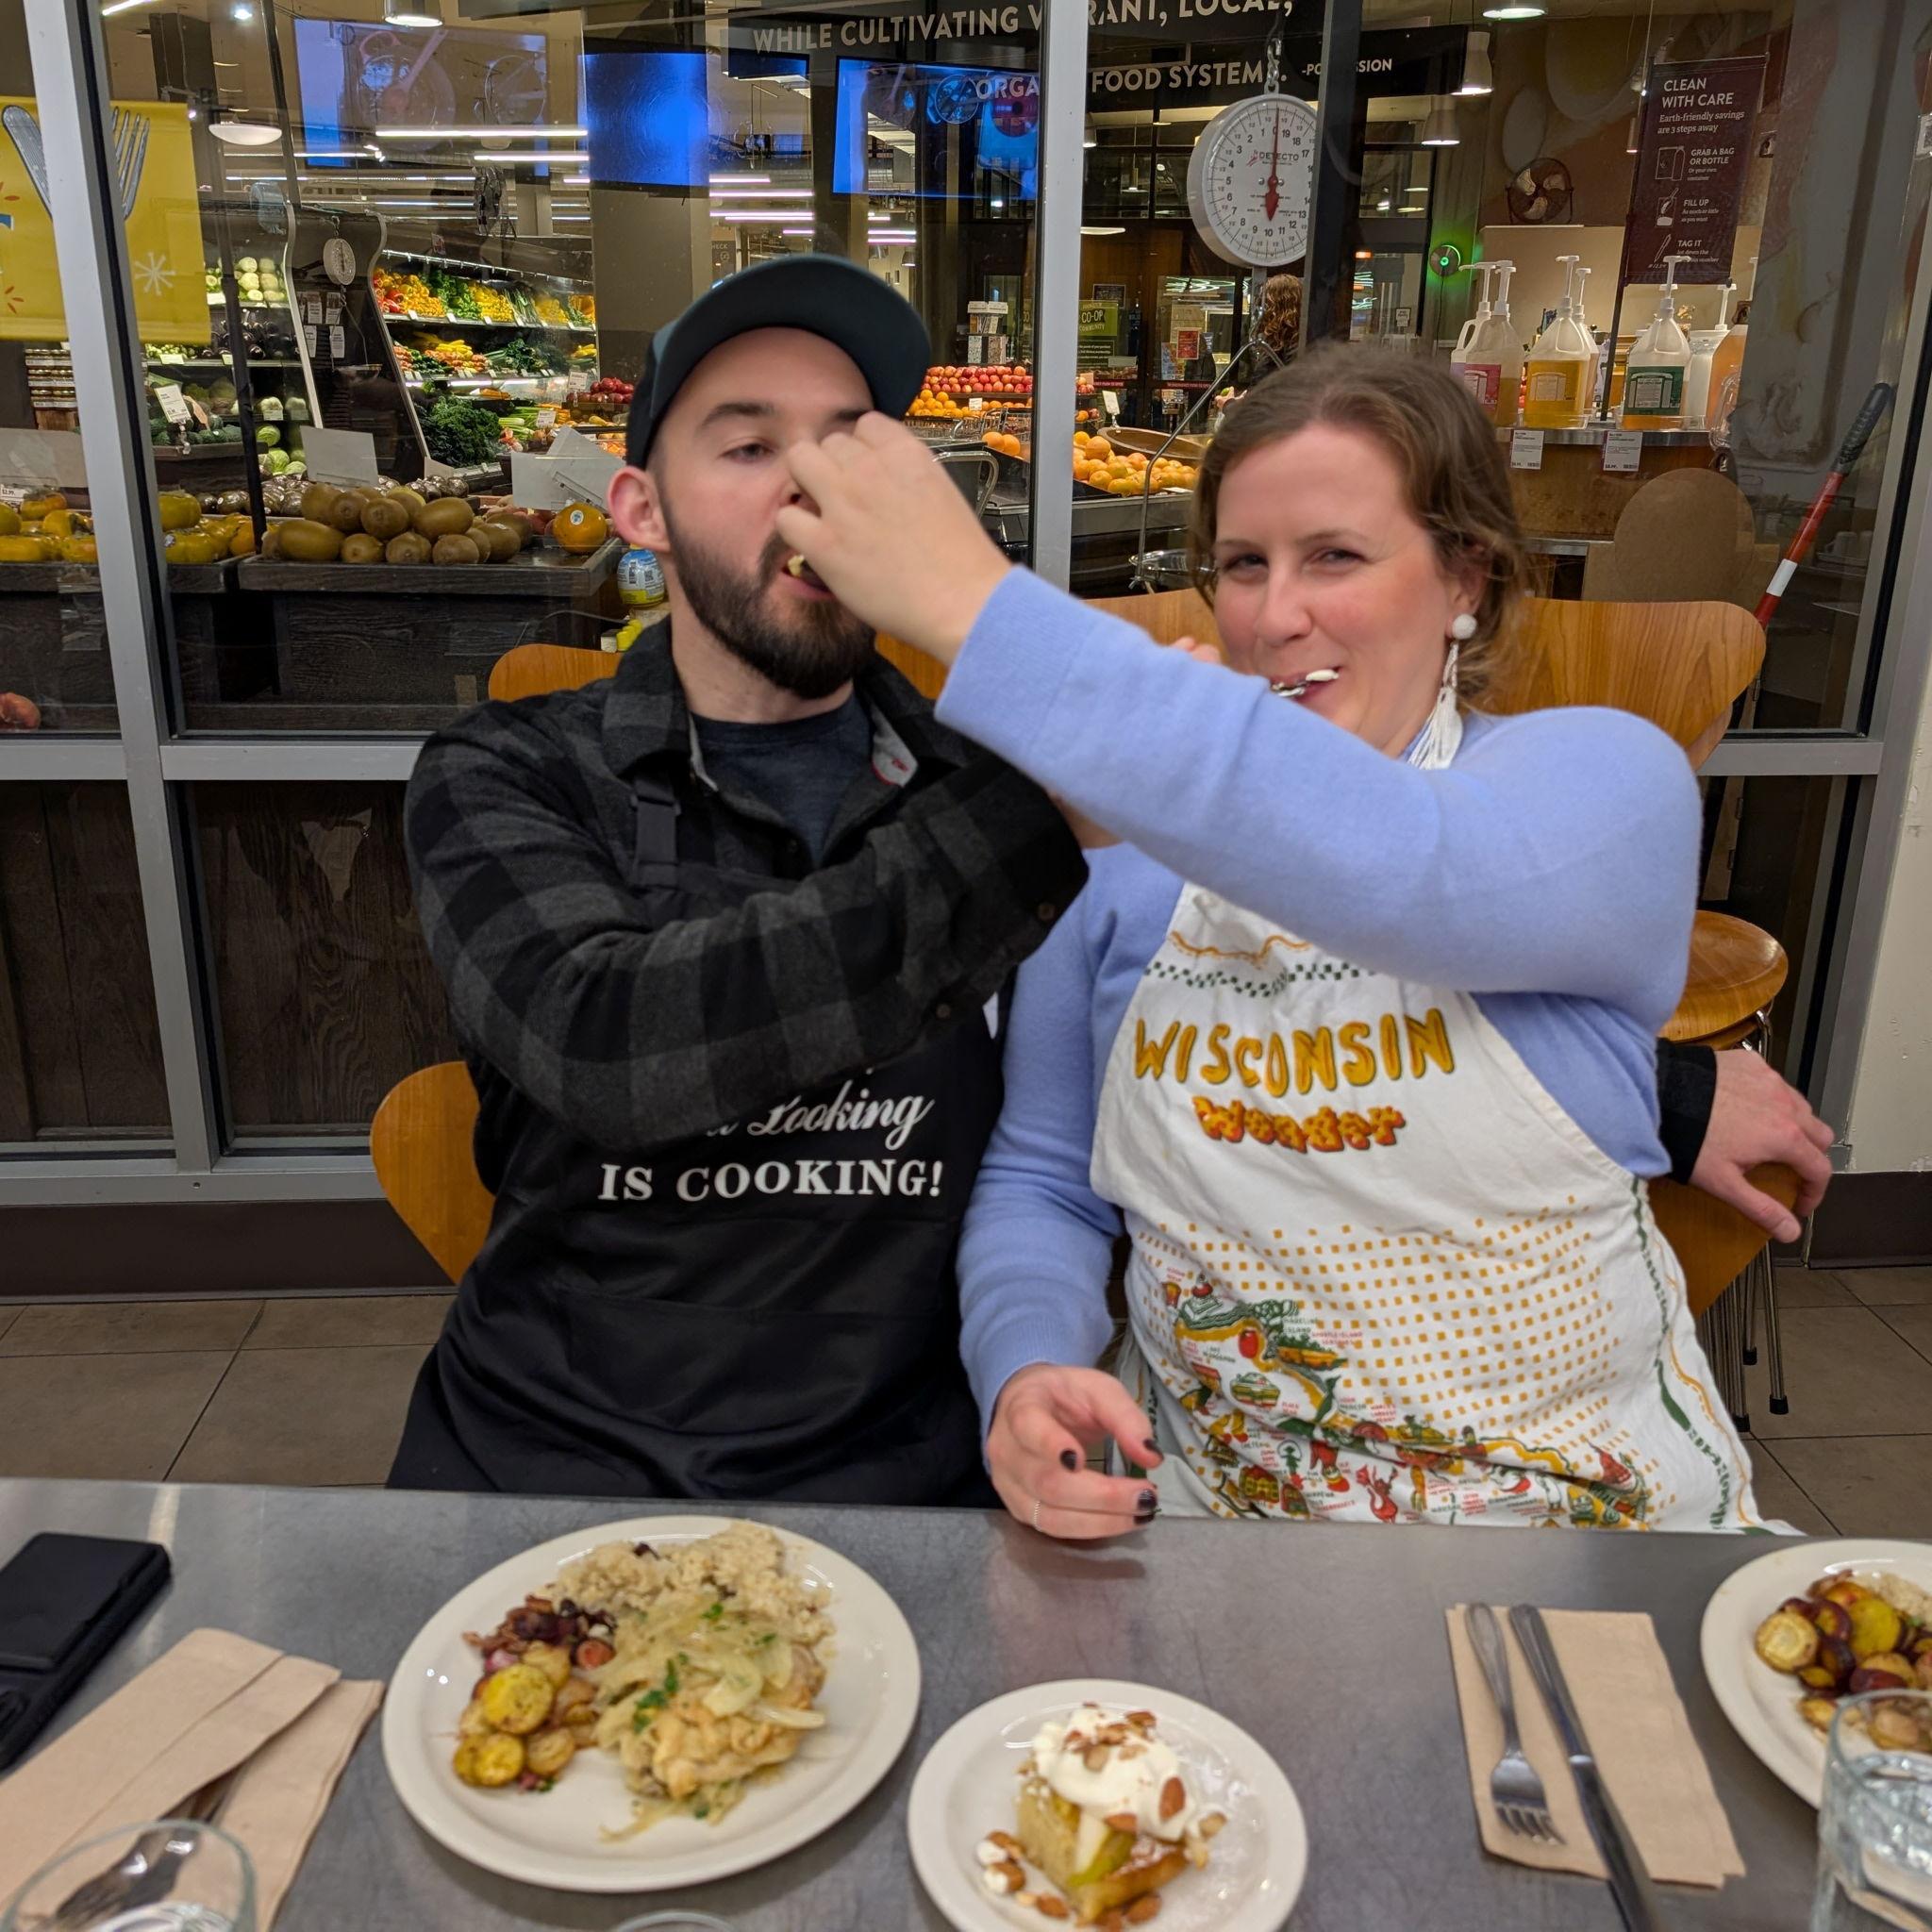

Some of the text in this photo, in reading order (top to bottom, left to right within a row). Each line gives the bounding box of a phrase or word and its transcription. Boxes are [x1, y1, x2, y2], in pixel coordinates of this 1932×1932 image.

[753, 24, 832, 54] WHILE
[841, 6, 1019, 46] CULTIVATING
[975, 76, 1041, 100] ORGA
[1091, 66, 1161, 92] FOOD
[1169, 60, 1288, 89] SYSTEM.
[1356, 58, 1392, 73] SION
[1663, 77, 1707, 92] CLEAN
[1661, 92, 1734, 108] WITH CARE
[1659, 109, 1745, 123] Earth-friendly savings
[1282, 129, 1291, 138] 19
[1676, 125, 1697, 135] steps
[1697, 125, 1719, 134] away
[1247, 134, 1253, 143] 2
[1292, 137, 1301, 145] 18
[1237, 145, 1242, 154] 3
[1302, 149, 1309, 158] 17
[1690, 148, 1711, 157] GRAB
[1719, 147, 1735, 156] BAG
[1702, 157, 1729, 165] BOTTLE
[1226, 176, 1232, 185] 5
[1226, 192, 1233, 201] 6
[1298, 210, 1307, 219] 13
[1240, 218, 1245, 226] 8
[1289, 221, 1297, 229] 12
[1253, 225, 1257, 234] 9
[1264, 228, 1274, 237] 10
[1278, 226, 1286, 235] 11
[1081, 309, 1104, 324] CO-OP
[1135, 1008, 1455, 1098] WISCONSIN
[1191, 1095, 1407, 1154] Wonder
[597, 1158, 943, 1202] IS COOKING!
